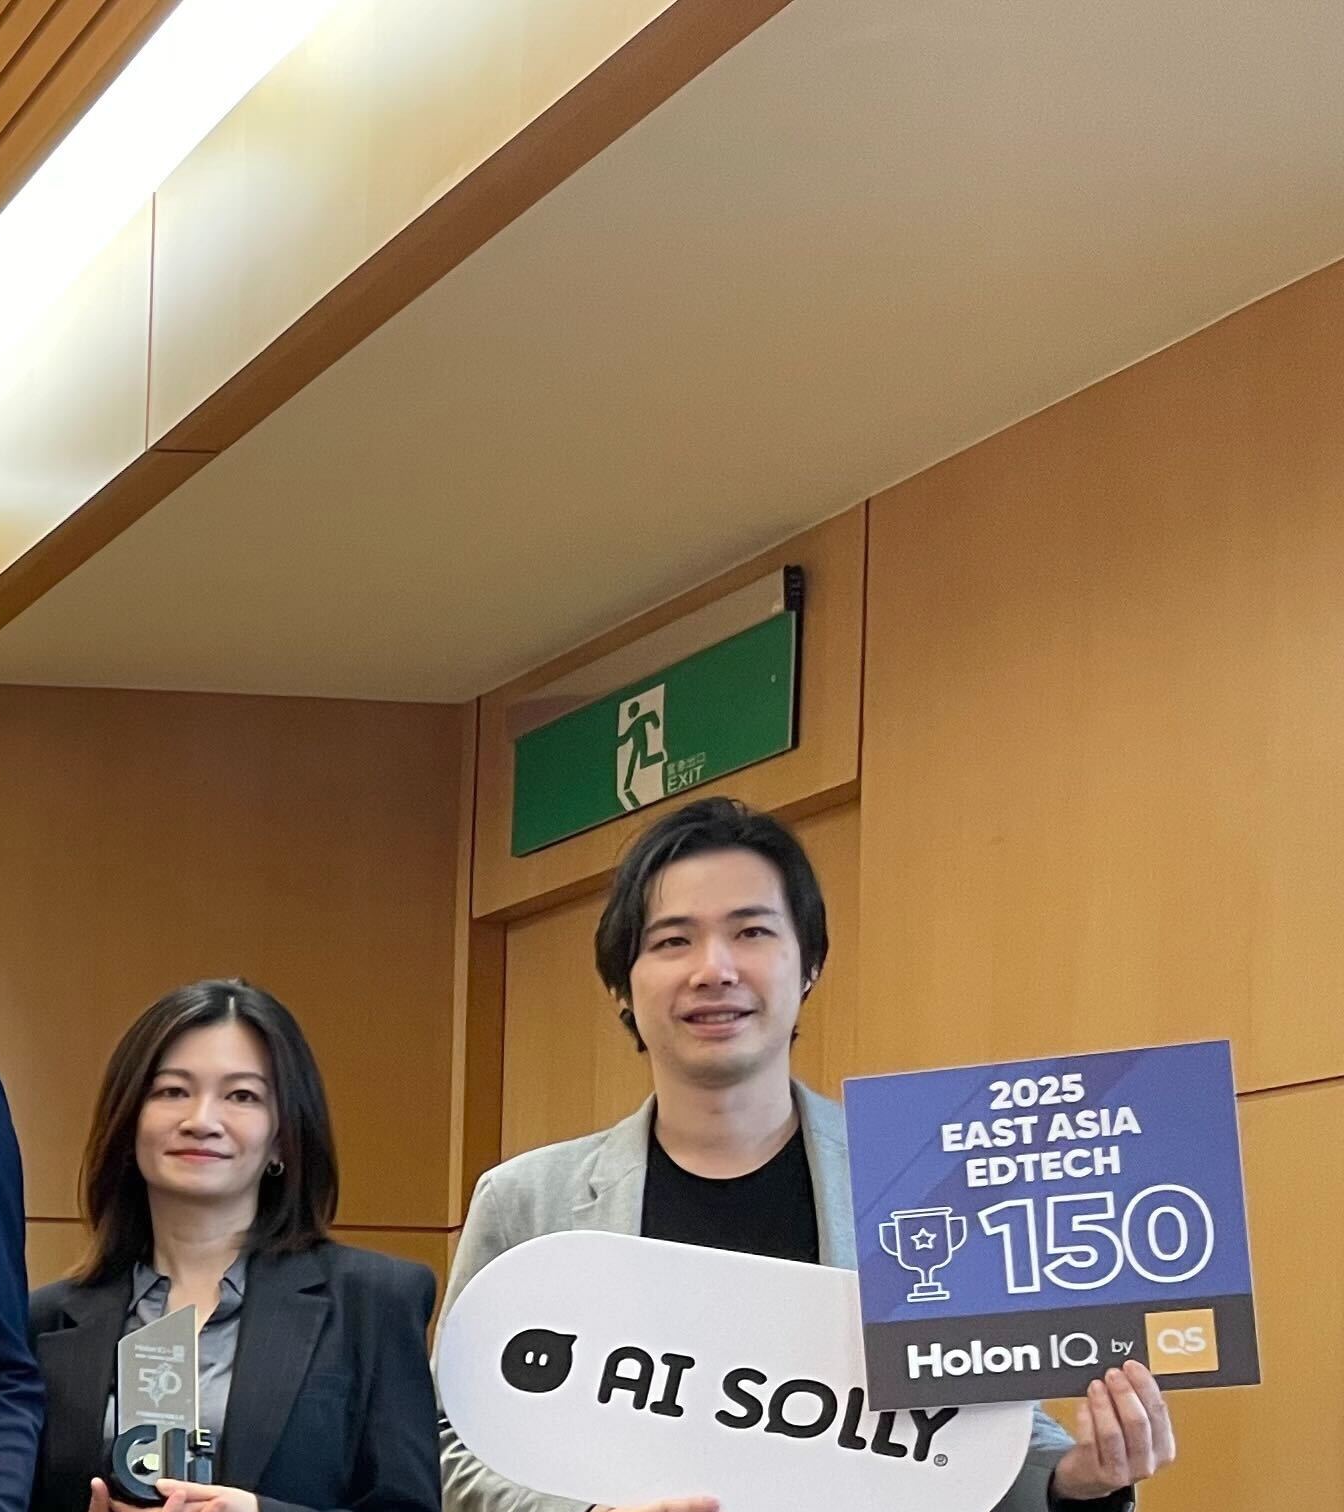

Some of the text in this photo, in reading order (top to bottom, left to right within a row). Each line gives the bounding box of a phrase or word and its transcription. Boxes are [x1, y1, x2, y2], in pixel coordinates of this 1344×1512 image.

[667, 764, 705, 793] EXIT
[989, 1073, 1085, 1110] 2025
[941, 1106, 1142, 1152] EAST ASIA
[966, 1145, 1120, 1187] EDTECH
[977, 1184, 1214, 1295] 150
[907, 1326, 1207, 1379] Holon IQ by QS
[597, 1346, 695, 1417] AI
